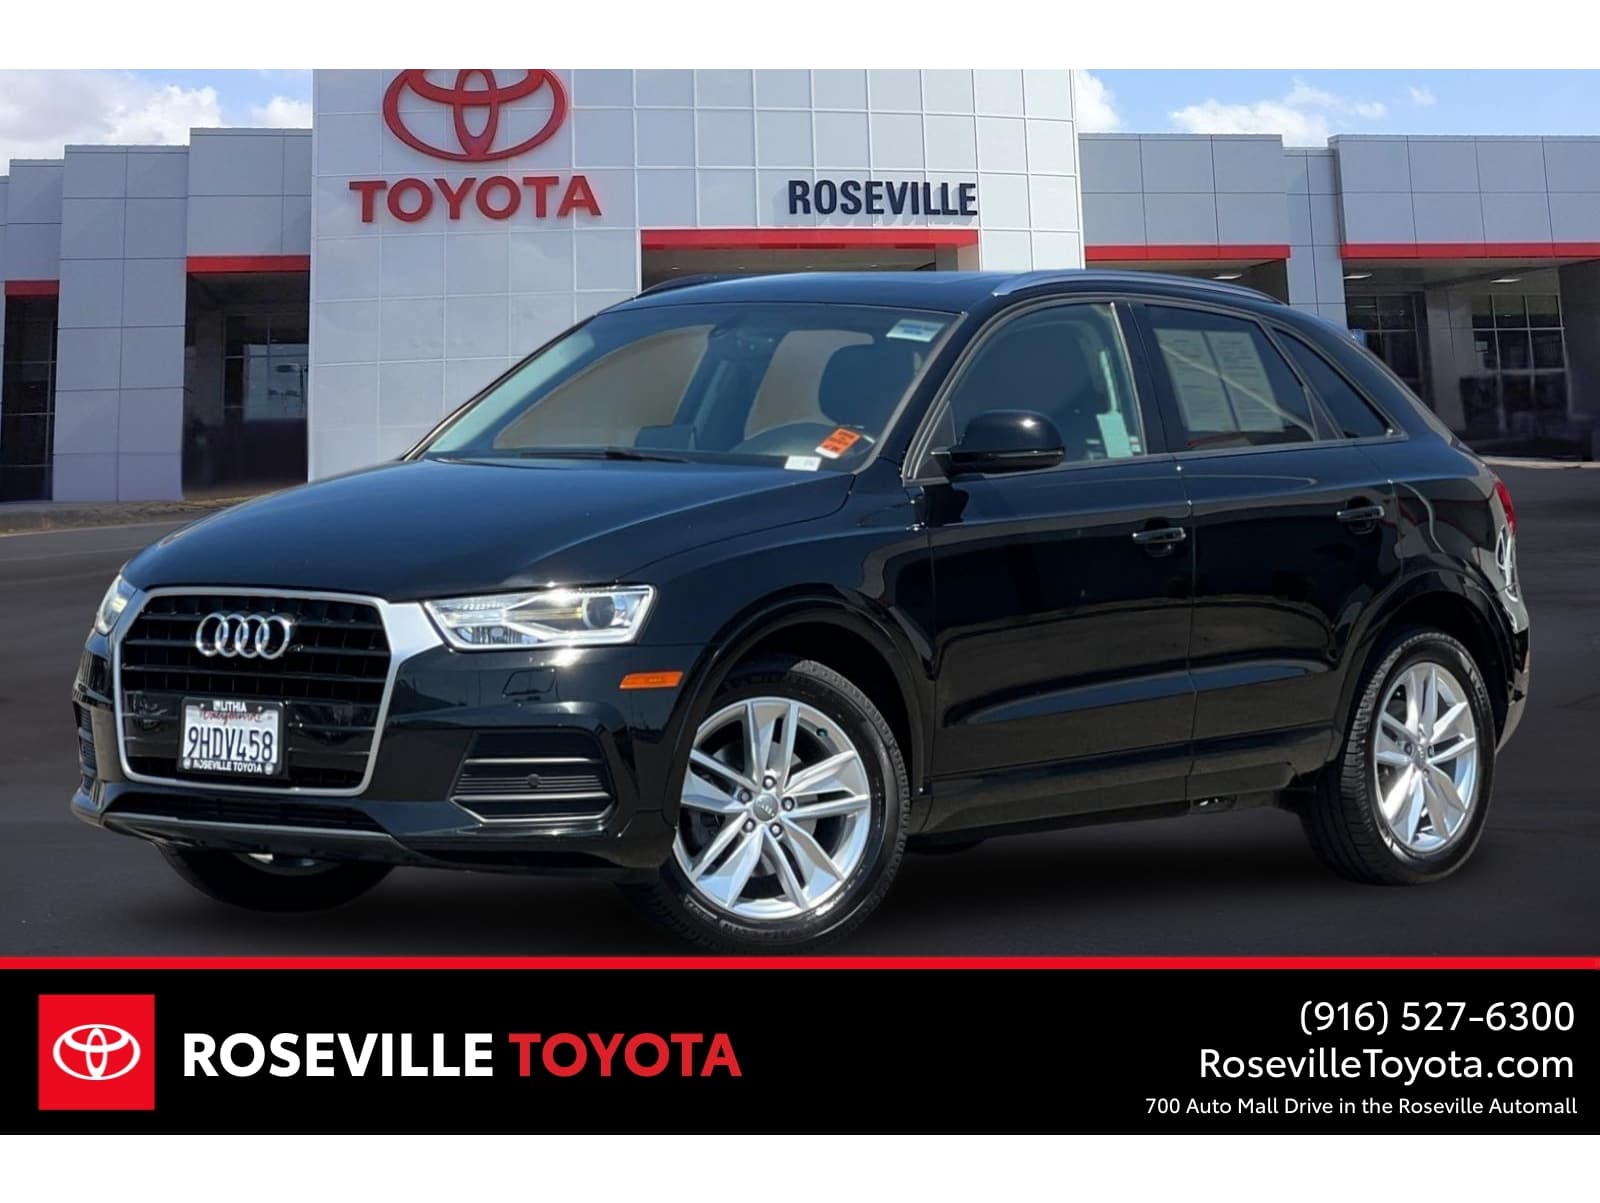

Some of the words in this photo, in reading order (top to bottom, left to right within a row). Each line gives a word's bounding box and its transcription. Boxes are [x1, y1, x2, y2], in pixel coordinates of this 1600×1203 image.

[349, 175, 602, 223] TOYOTA
[788, 179, 978, 216] ROSEVILLE
[221, 700, 247, 712] LITHIA
[188, 726, 273, 761] 9HDV458
[233, 762, 263, 773] TOYOTA
